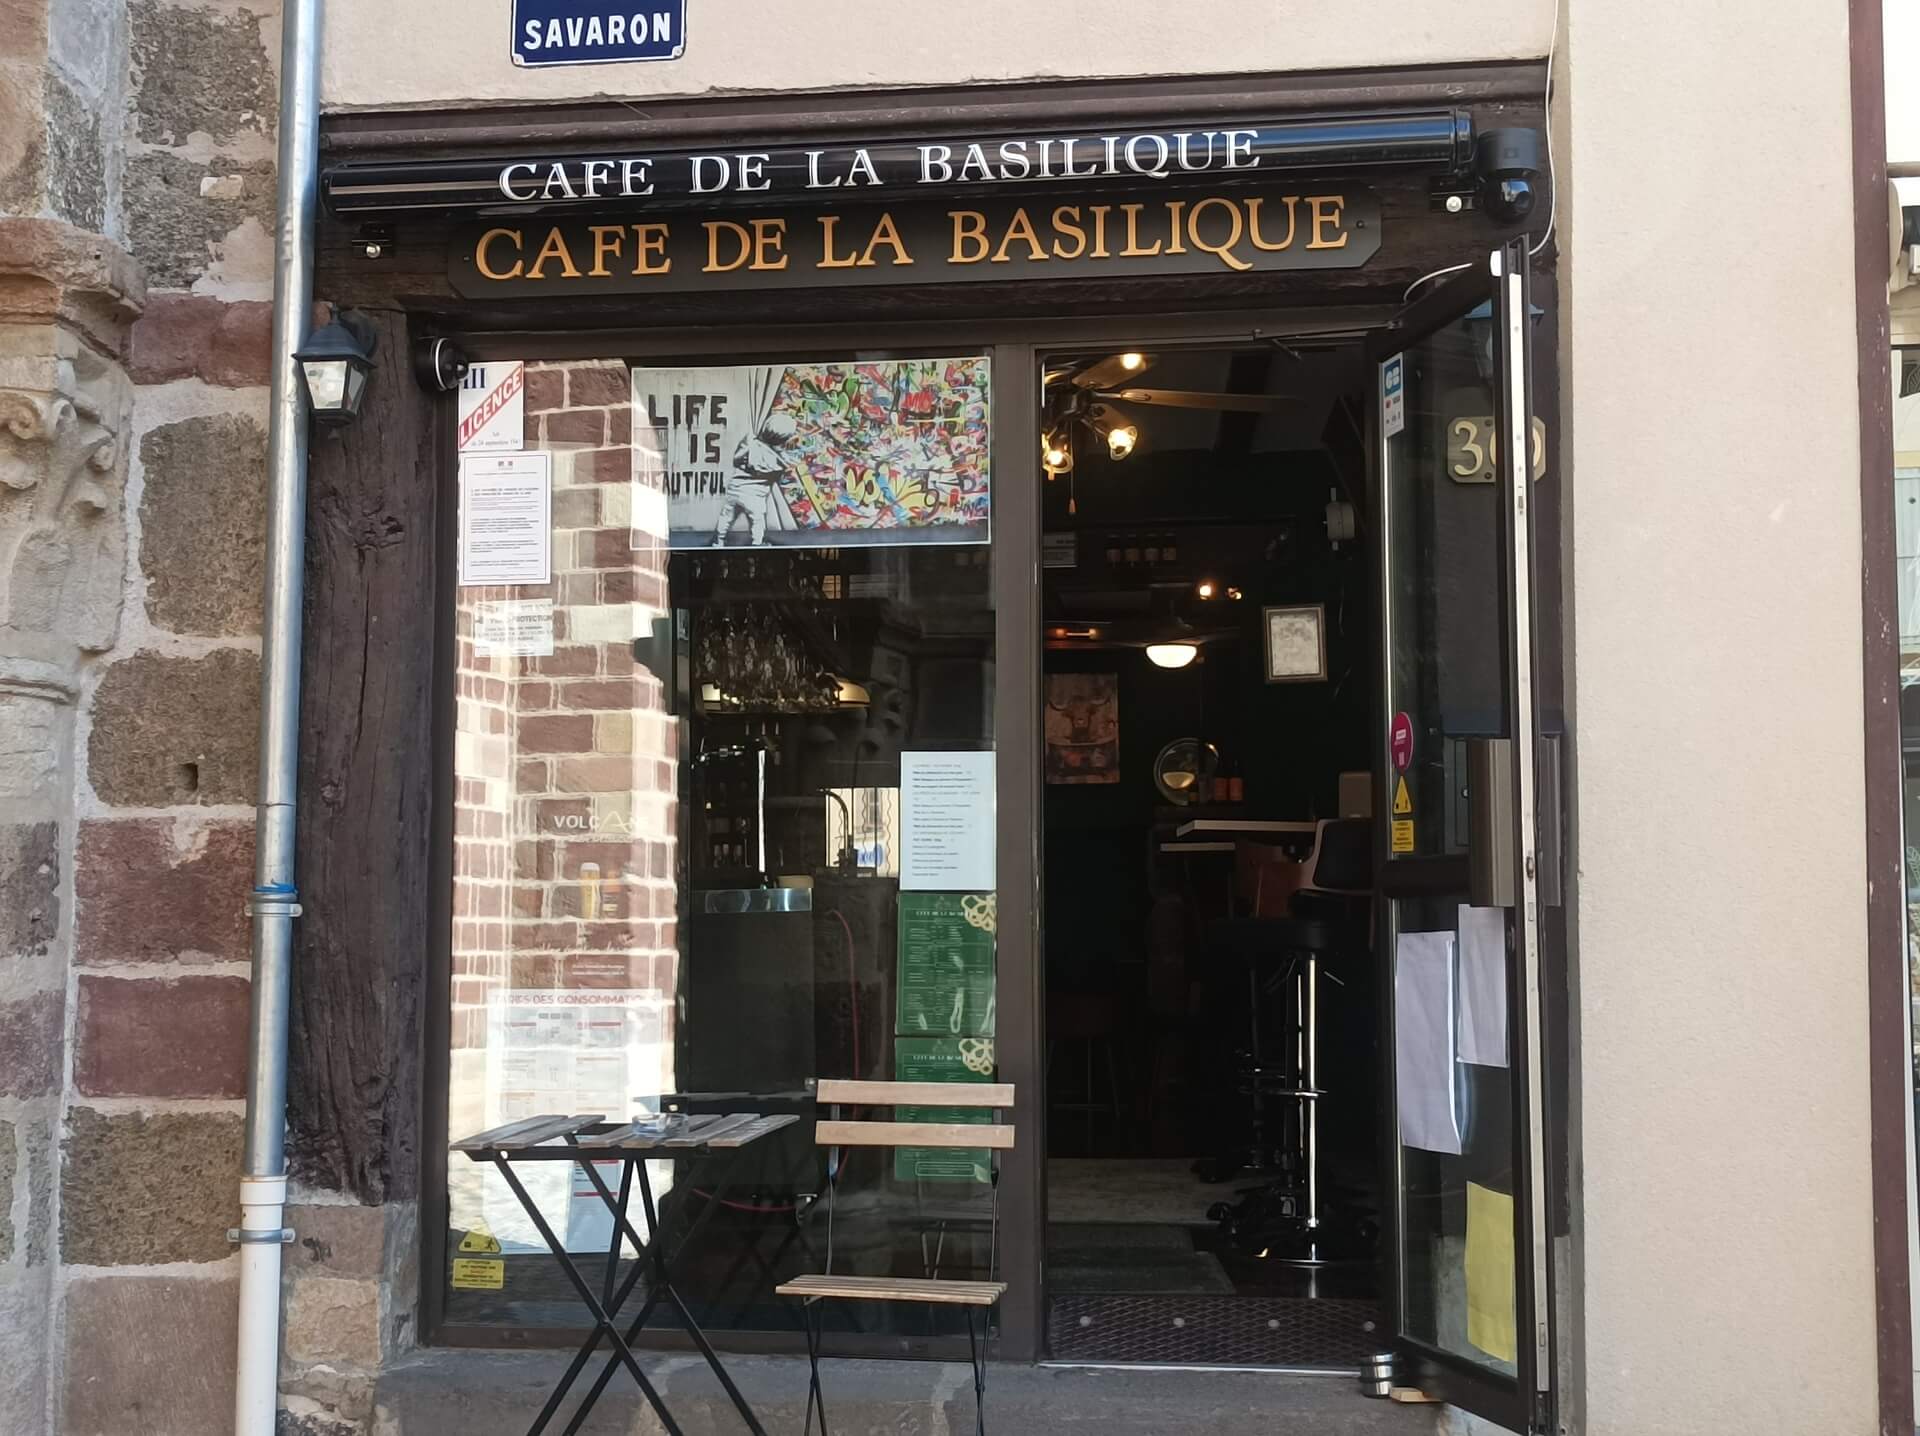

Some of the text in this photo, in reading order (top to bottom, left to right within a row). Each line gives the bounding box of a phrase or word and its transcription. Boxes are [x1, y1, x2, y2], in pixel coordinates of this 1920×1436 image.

[524, 12, 671, 50] SAVARON
[500, 129, 1261, 200] CAFE DE LA BASILIQUE
[475, 195, 1349, 280] CAFE DE LA BASILIQUE
[460, 368, 522, 446] LICENCE
[647, 394, 728, 430] LIFE
[690, 432, 721, 464] IS
[496, 992, 657, 1005] TRIFS DES CONSOMMATIOS
